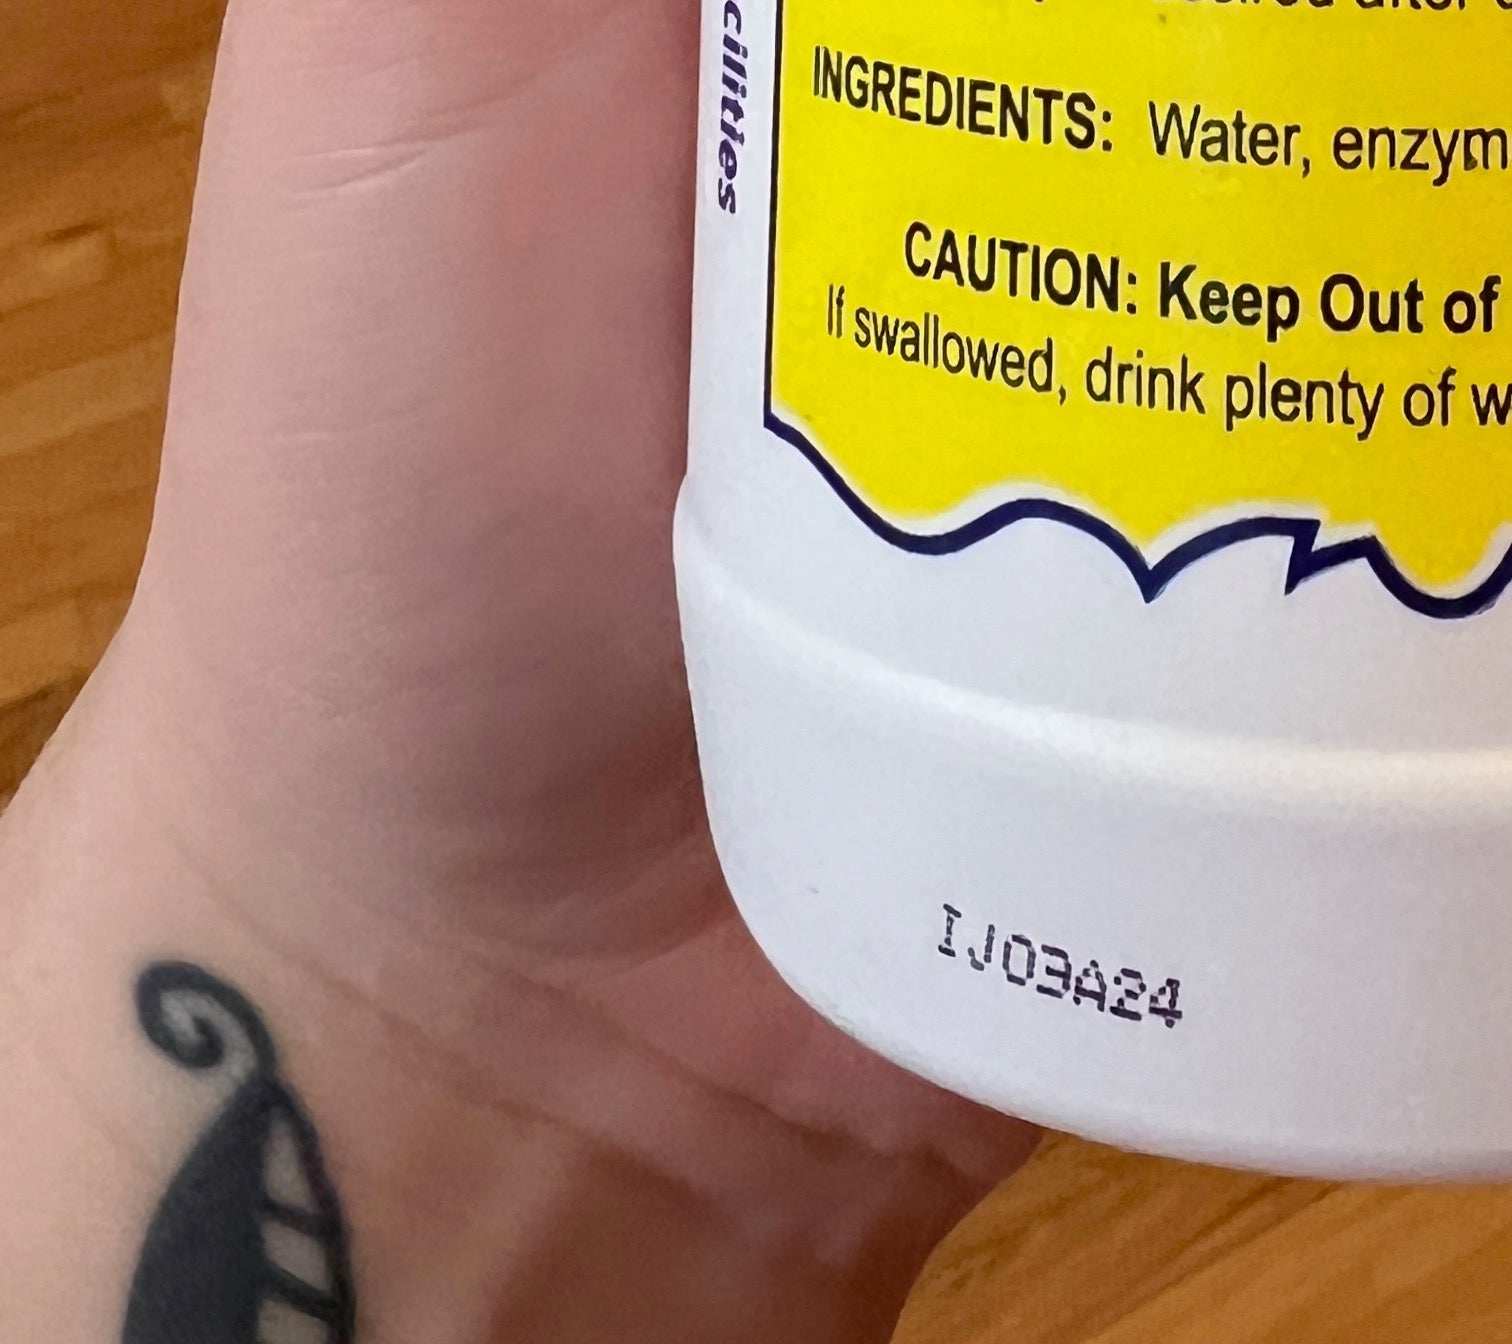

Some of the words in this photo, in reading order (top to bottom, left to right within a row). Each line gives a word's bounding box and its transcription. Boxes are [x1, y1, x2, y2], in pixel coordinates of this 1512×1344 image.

[813, 45, 1113, 152] INGREDIENTS:
[1148, 100, 1311, 179] Water,
[904, 221, 1137, 315] CAUTION:
[1159, 261, 1300, 343] Keep
[1320, 273, 1425, 334] Out
[1443, 274, 1502, 334] of
[827, 284, 845, 339] If
[854, 306, 1067, 406] swallowed,
[1085, 345, 1206, 415] drink
[1225, 360, 1385, 442] plenty
[1403, 365, 1457, 427] of
